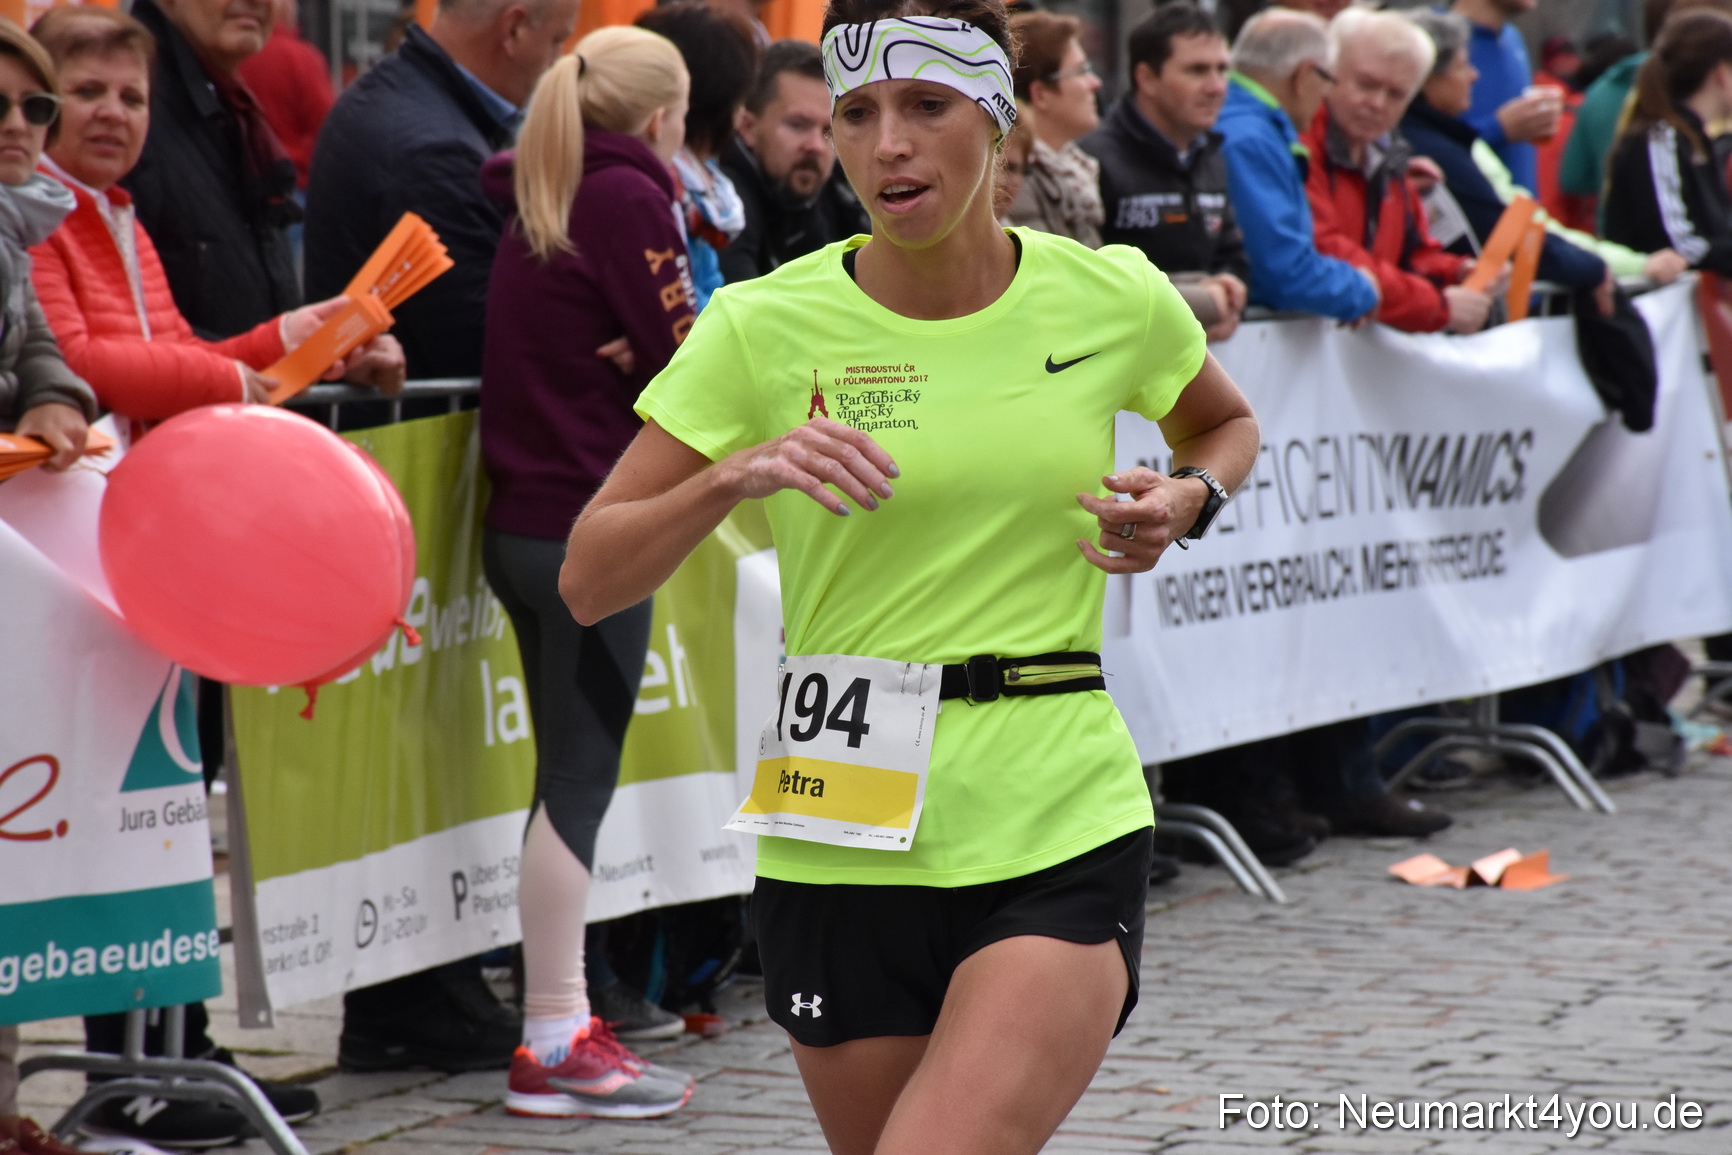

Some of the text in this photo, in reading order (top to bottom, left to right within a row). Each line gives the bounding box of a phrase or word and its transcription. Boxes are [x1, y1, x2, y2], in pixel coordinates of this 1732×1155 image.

[845, 363, 916, 374] MISTROVSTVÍ ČR
[834, 374, 929, 386] V PŮLMARATONU 2017
[835, 388, 921, 406] Pardubický
[836, 403, 894, 420] vinařský
[777, 769, 825, 798] Petra
[119, 807, 156, 833] Jura
